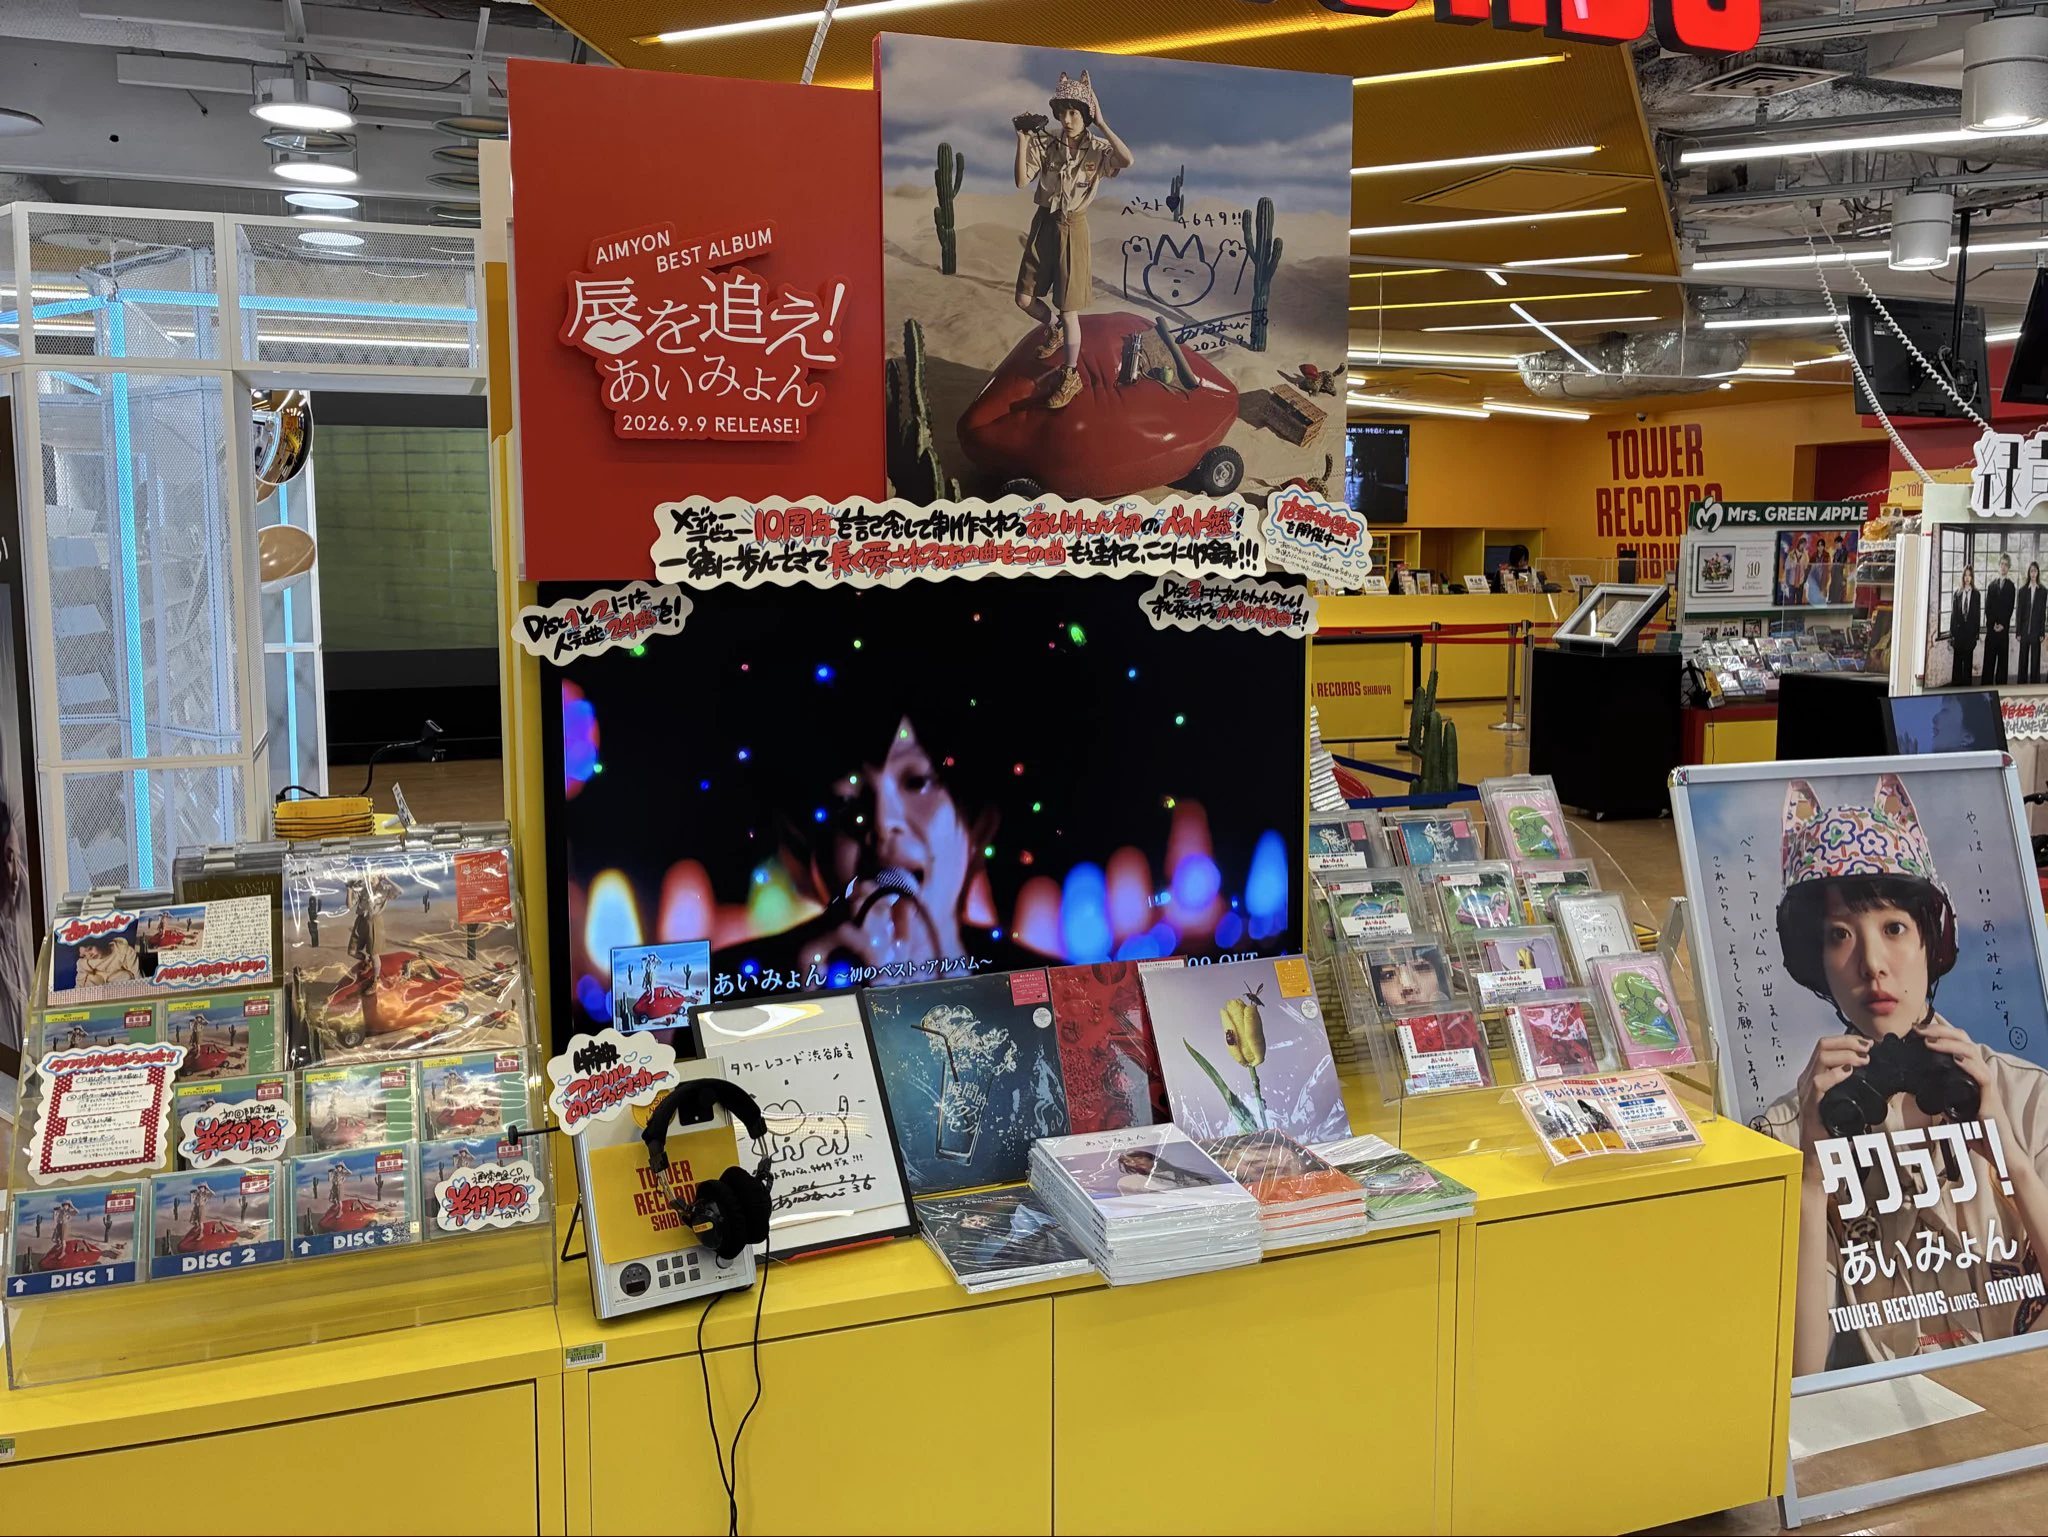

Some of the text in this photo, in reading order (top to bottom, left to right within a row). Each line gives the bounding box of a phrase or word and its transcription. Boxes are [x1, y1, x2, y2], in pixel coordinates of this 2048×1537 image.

[596, 230, 671, 264] AIMYON
[657, 228, 772, 273] BEST ALBUM
[568, 274, 845, 362] 唇を追え!
[605, 355, 818, 407] あいみょん
[623, 415, 800, 433] 2026.9.9 RELEASE!
[1607, 423, 1704, 480] TOWER
[1727, 506, 1868, 521] Mrs. GREEN APPLE
[1317, 681, 1391, 697] RECORDS SHIBUYA
[1740, 835, 1786, 1068] ベストアルバムが出ました!!
[714, 967, 826, 997] あいみょん
[1982, 920, 2010, 1027] あいみょんです
[1544, 1086, 1591, 1100] あいみょん
[192, 1117, 282, 1160] ¥6930
[1814, 1118, 2015, 1219] タワラブ!
[446, 1182, 528, 1226] ¥4950
[633, 1182, 699, 1216] RECRD
[333, 1228, 394, 1249] DISC 3
[651, 1211, 682, 1231] SHIB
[182, 1248, 256, 1272] DISC 2
[1840, 1219, 2018, 1286] あいみょん
[51, 1268, 114, 1288] DISC 1
[1829, 1302, 1882, 1333] TOWER
[1881, 1290, 1949, 1323] RECORDS
[1984, 1272, 2046, 1306] AIMYON
